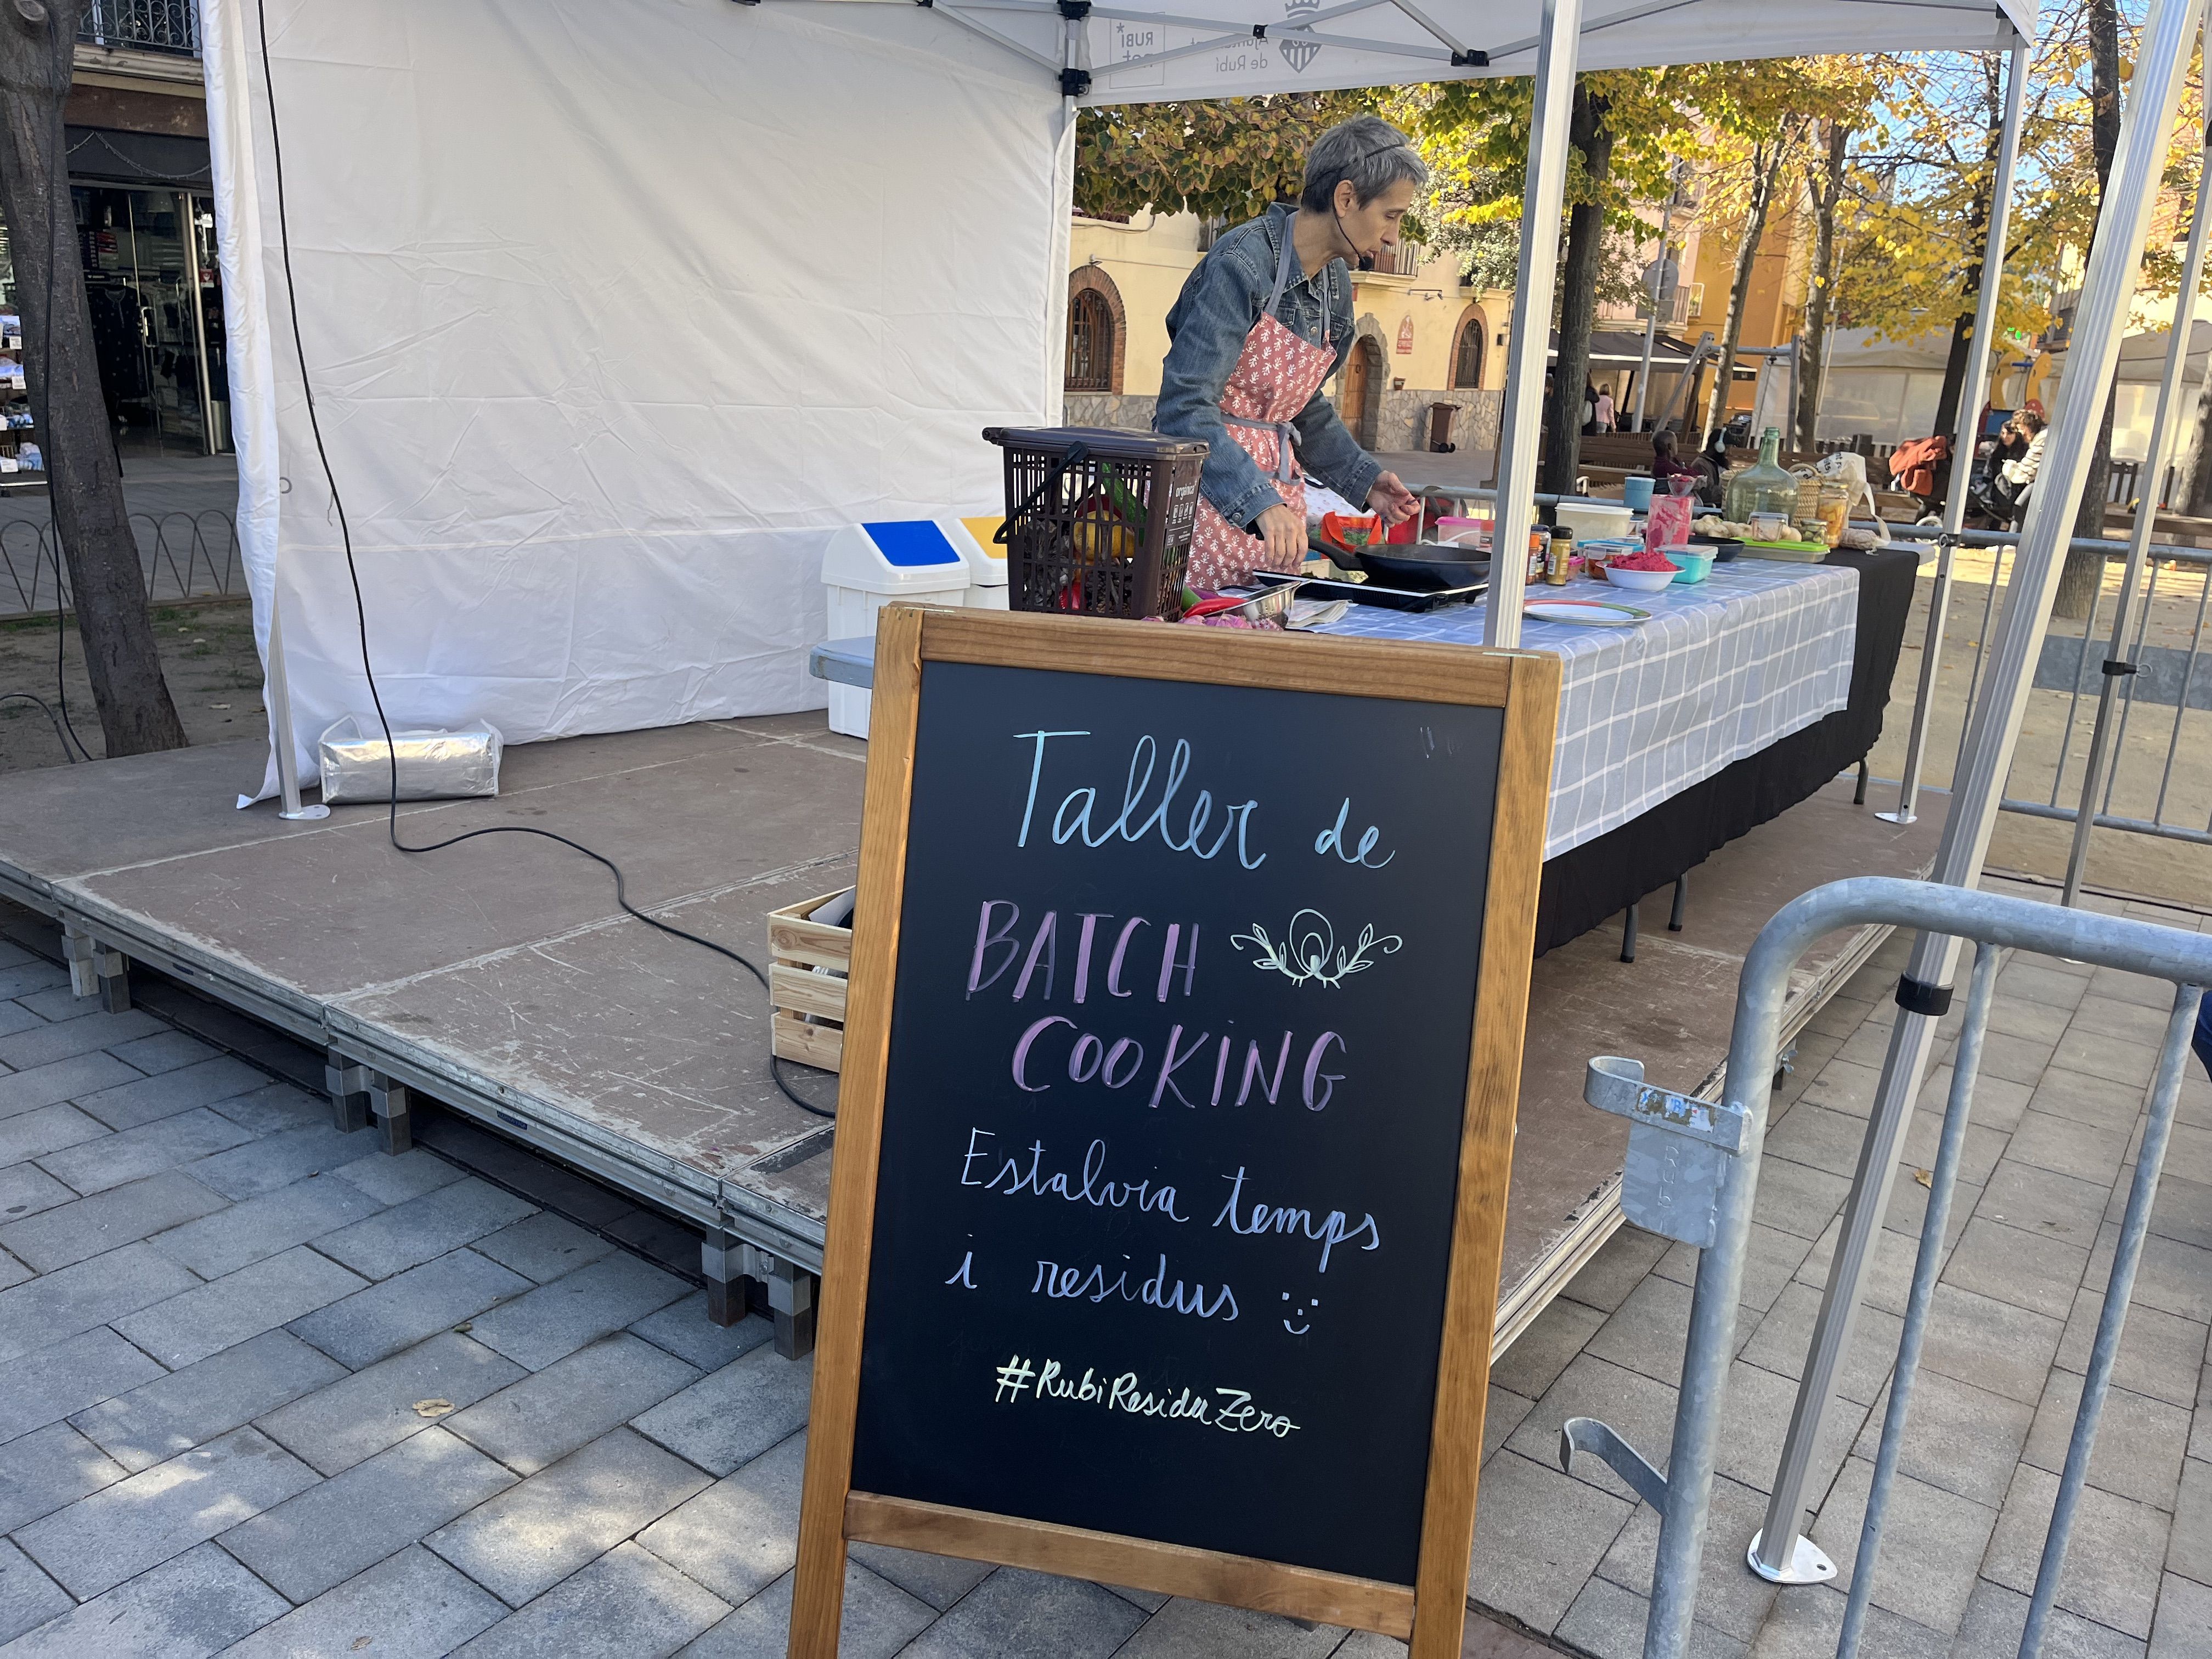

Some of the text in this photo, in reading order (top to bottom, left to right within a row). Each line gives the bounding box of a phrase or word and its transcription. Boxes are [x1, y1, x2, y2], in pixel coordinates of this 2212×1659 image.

[1013, 730, 1396, 870] Taller de
[966, 899, 1199, 1004] BATCH
[1011, 1015, 1347, 1111] COOKING
[961, 1127, 1380, 1273] Estalvia temps
[945, 1233, 1239, 1321] i residus
